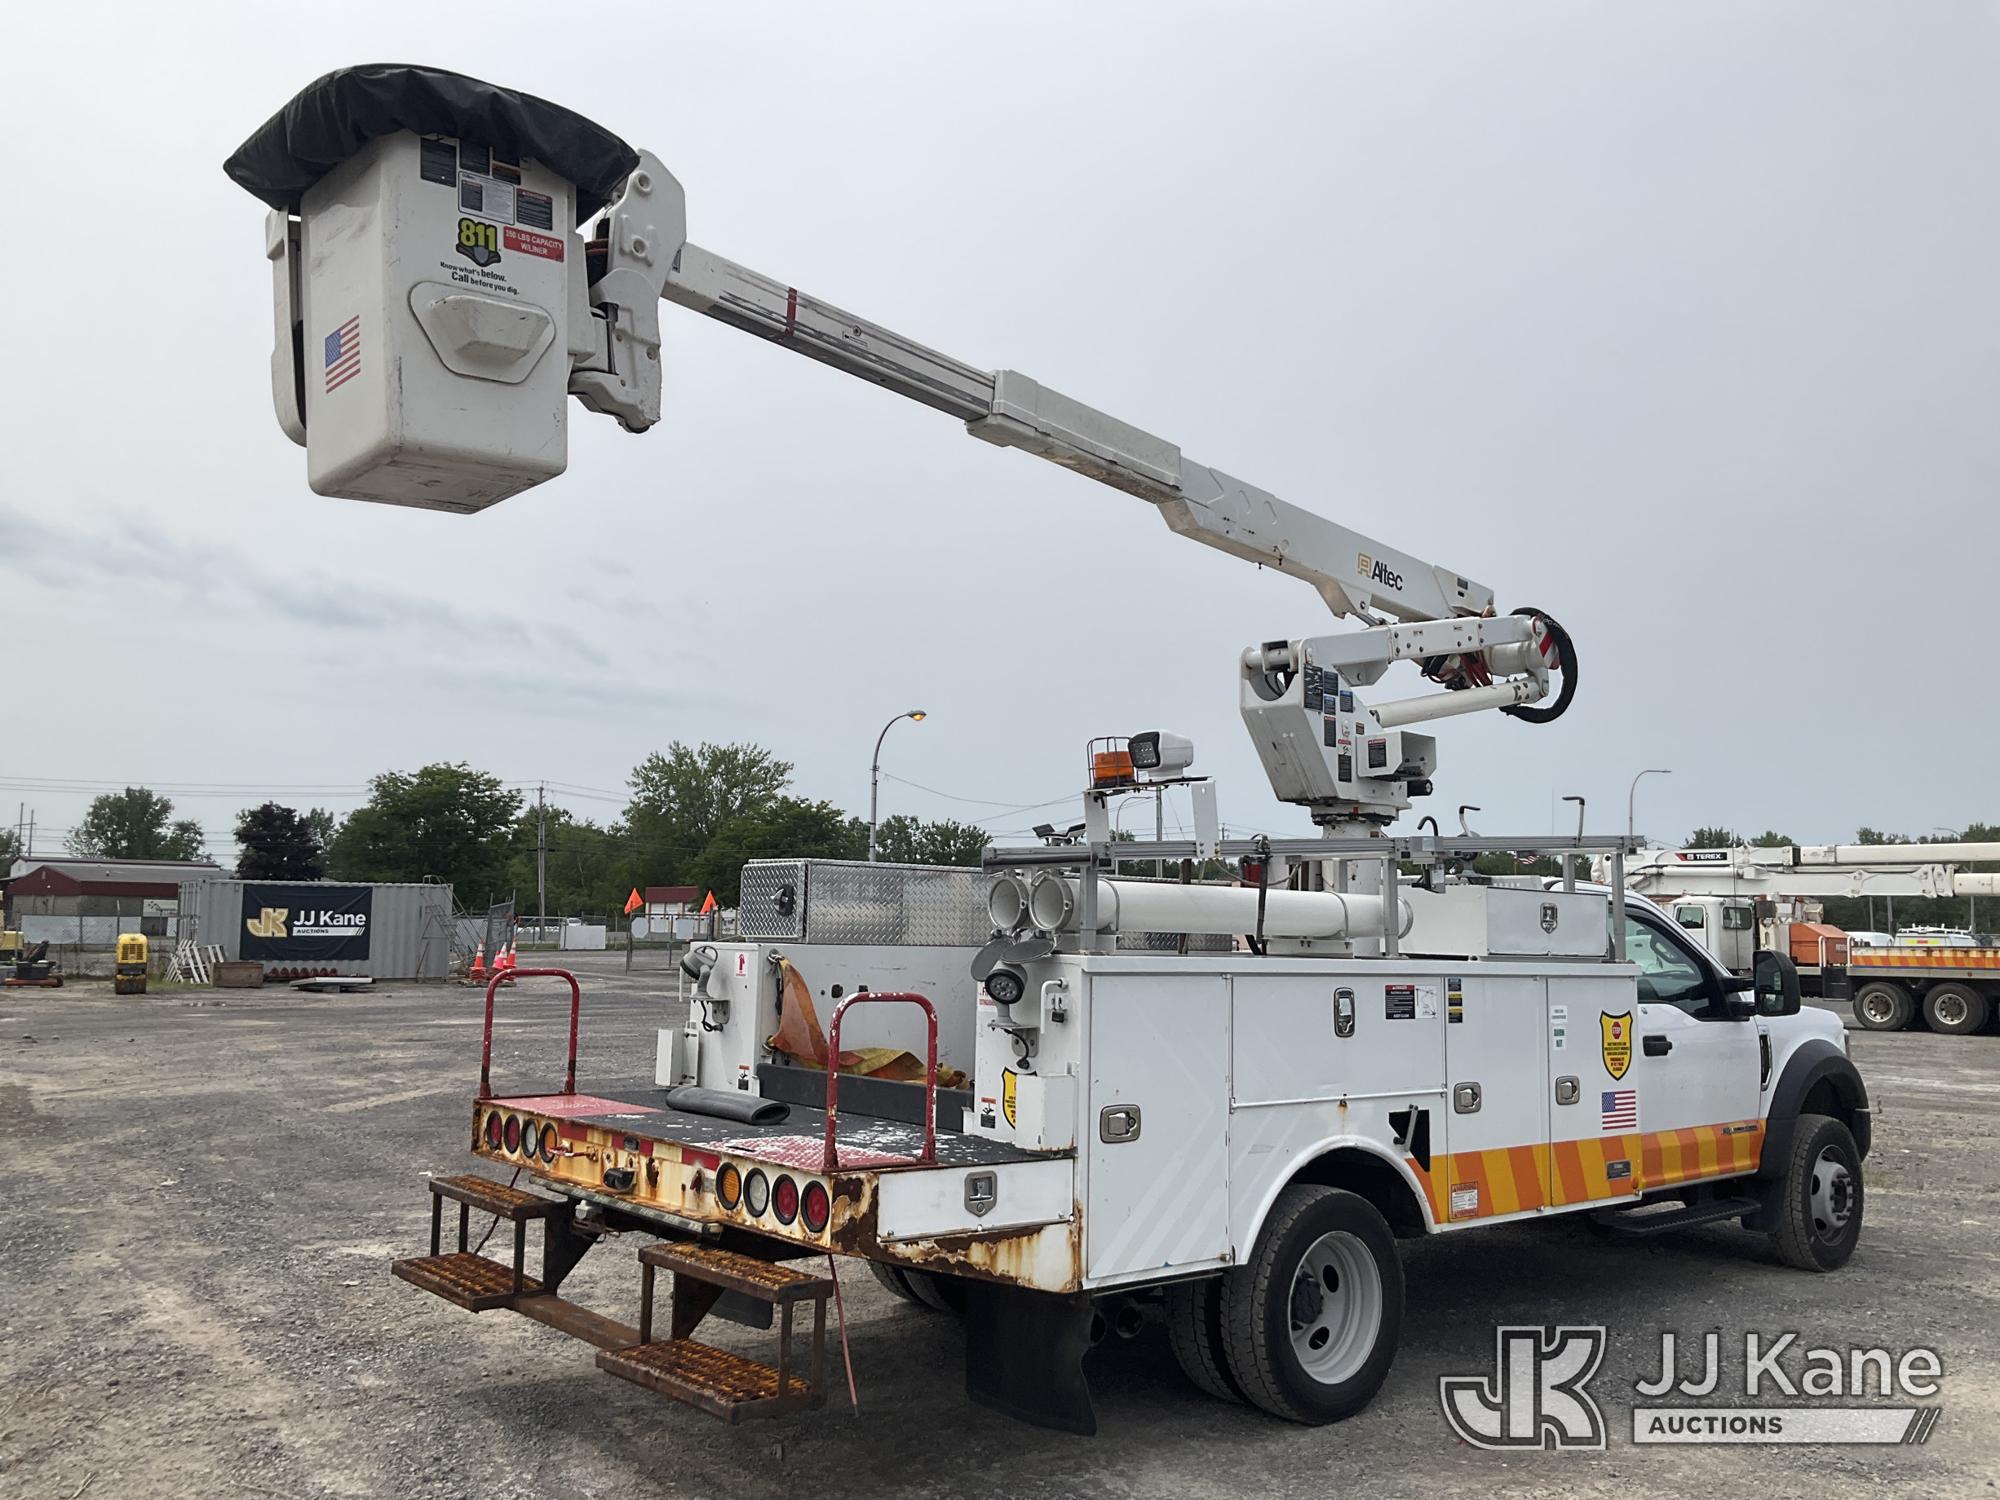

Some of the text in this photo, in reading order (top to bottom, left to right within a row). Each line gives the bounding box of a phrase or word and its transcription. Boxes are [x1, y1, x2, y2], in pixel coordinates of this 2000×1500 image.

[459, 219, 497, 252] 811
[518, 233, 530, 242] LBS
[531, 236, 563, 250] CAPACITY
[440, 261, 507, 282] Know what's below.
[451, 271, 520, 296] Call before you dig.
[1371, 560, 1403, 591] Altec
[246, 907, 289, 938] JK
[293, 910, 366, 926] JJ Kane
